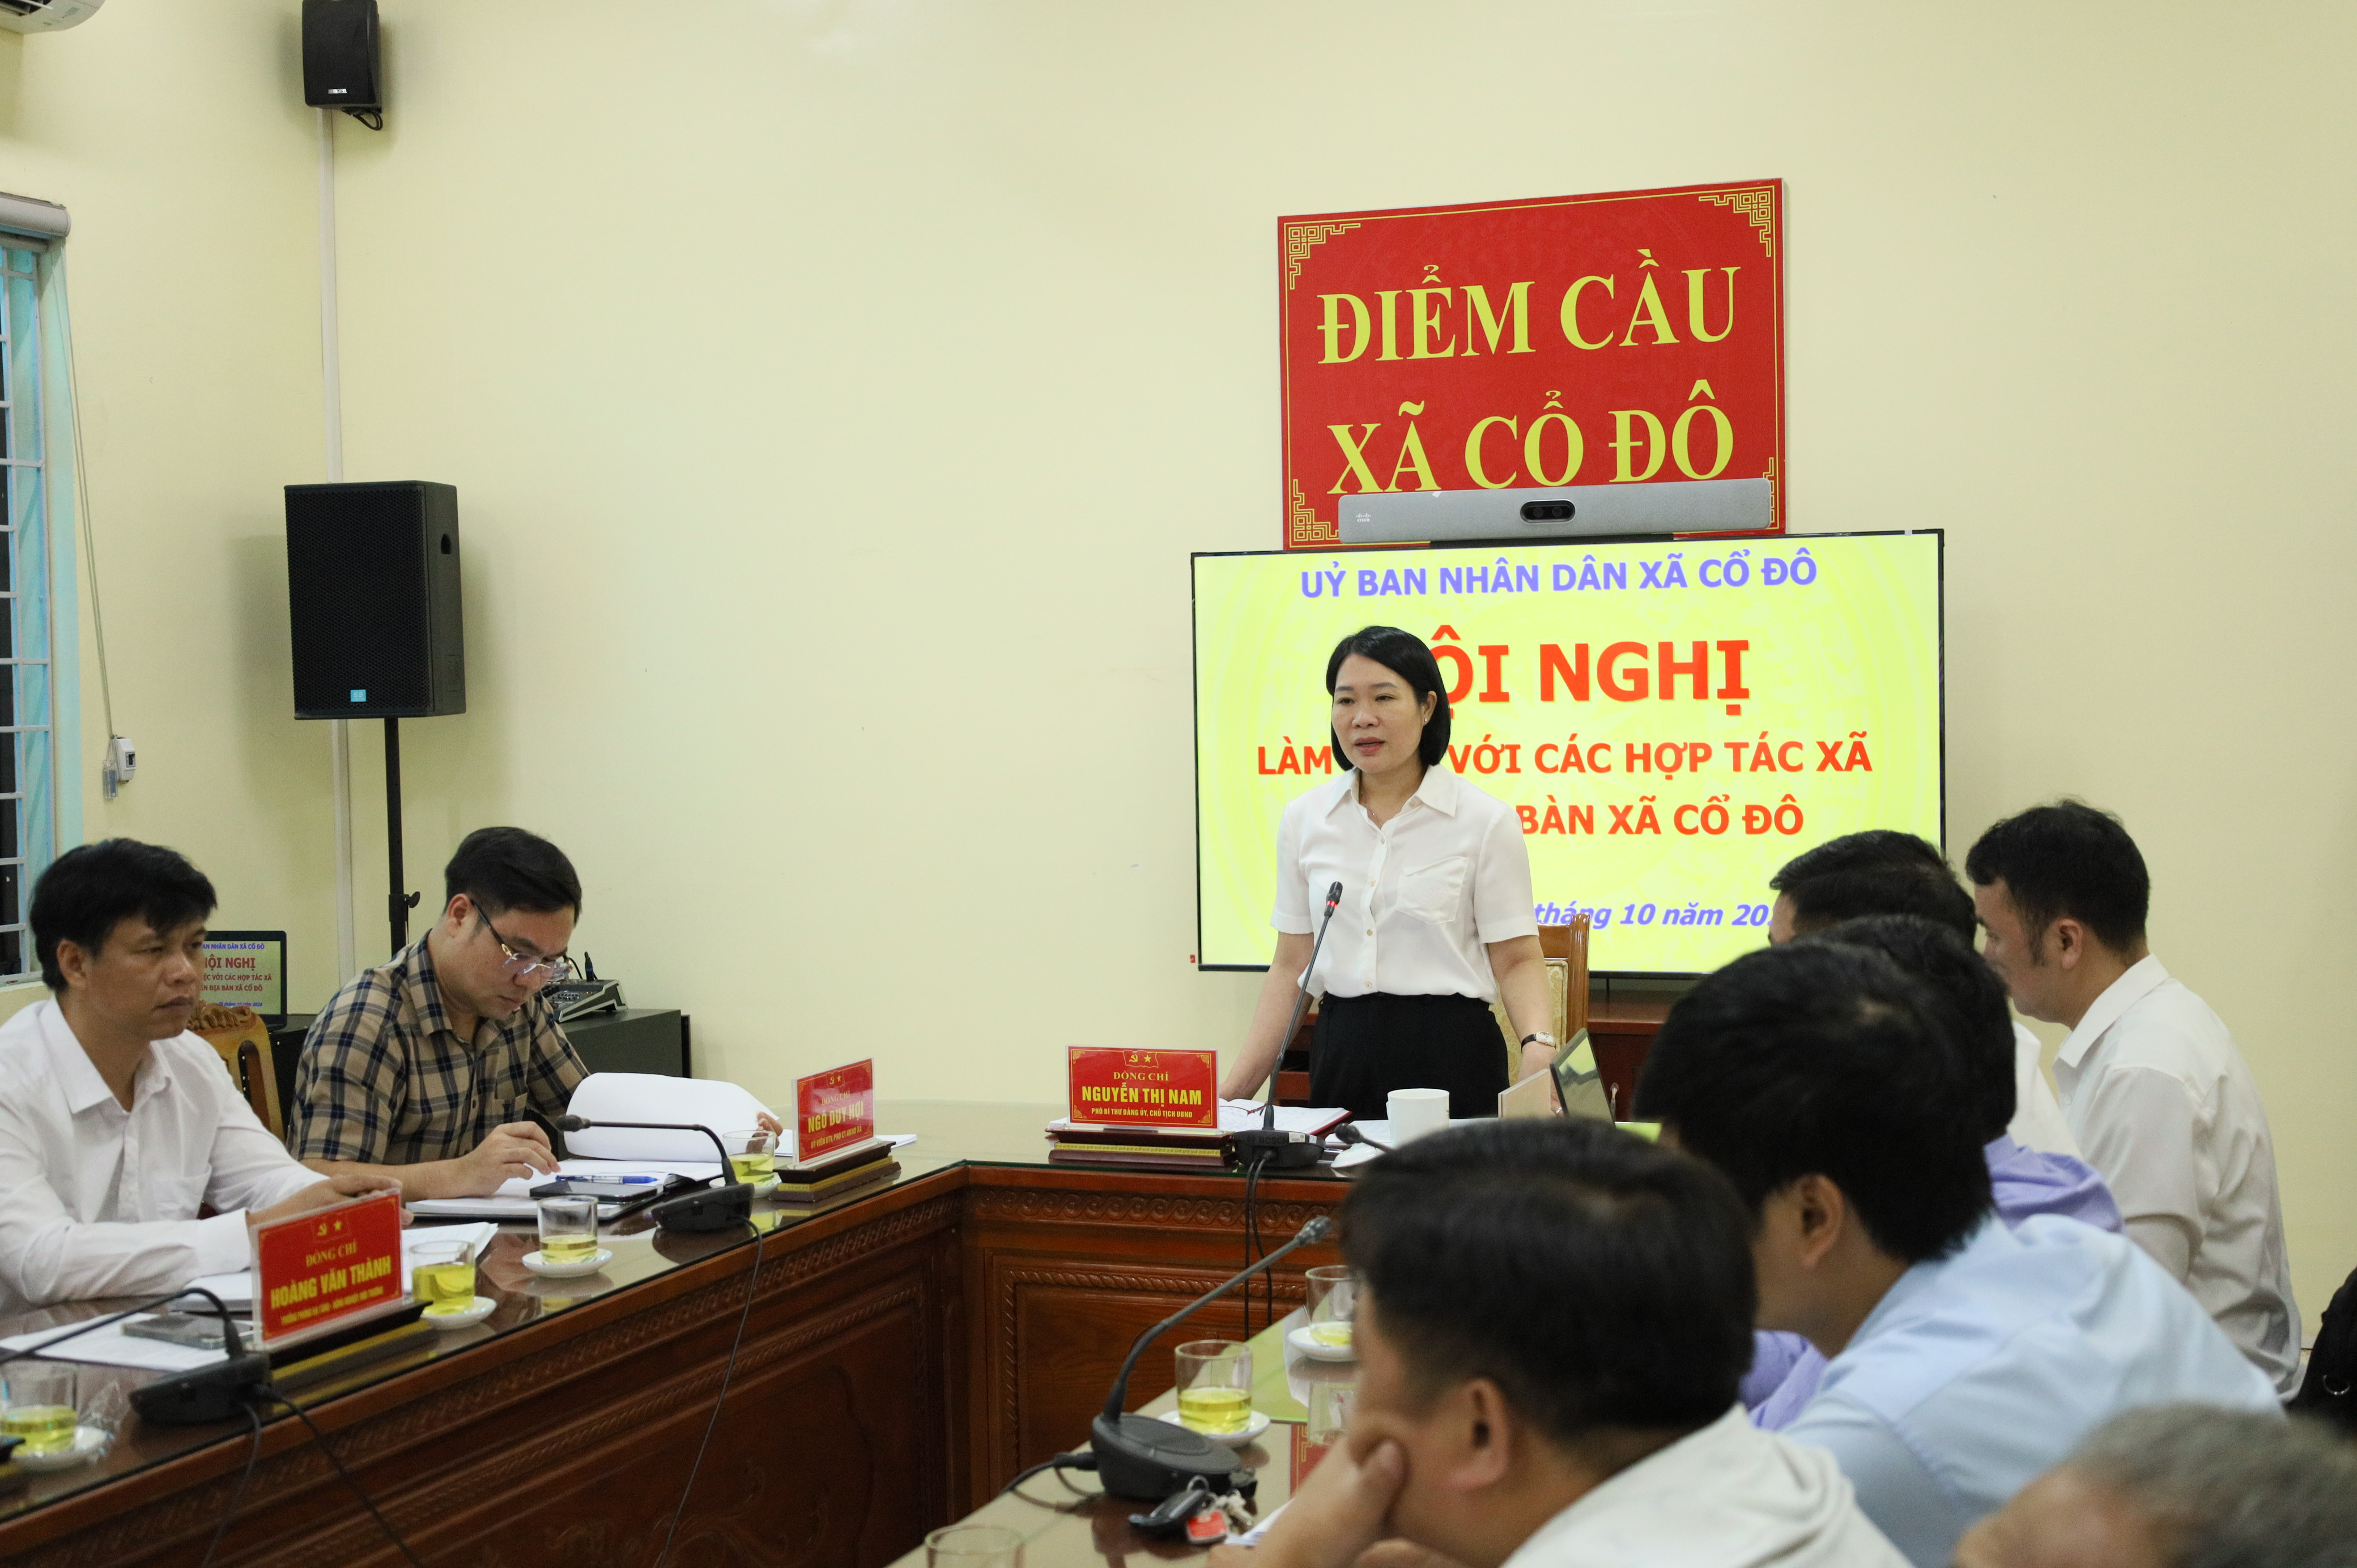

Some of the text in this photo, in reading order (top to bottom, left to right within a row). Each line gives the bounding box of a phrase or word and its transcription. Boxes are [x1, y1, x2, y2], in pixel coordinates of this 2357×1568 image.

[1317, 249, 1740, 363] ĐIỂM CẦU
[1327, 380, 1733, 493] XÃ CỔ ĐÔ
[1300, 547, 1817, 598] UỶ BAN NHÂN DÂN XÃ CỔ ĐÔ
[1429, 625, 1750, 719] ỘI NGHỊ
[1257, 731, 1873, 780] LÀM VỚI CÁC HỢP TÁC XÃ
[1516, 794, 1803, 835] BÀN XÃ CỔ ĐÔ
[1619, 903, 1656, 925] 10
[1662, 902, 1724, 926] năm
[1731, 904, 1772, 926] 20
[226, 957, 256, 971] NGHỊ
[1082, 1082, 1201, 1107] NGUYỄN THỊ NAM
[1148, 1071, 1168, 1081] CHÍ
[808, 1110, 827, 1133] NGÔ
[829, 1106, 846, 1126] DUY
[270, 1278, 318, 1310] HOÀNG
[320, 1268, 347, 1294] VĂN
